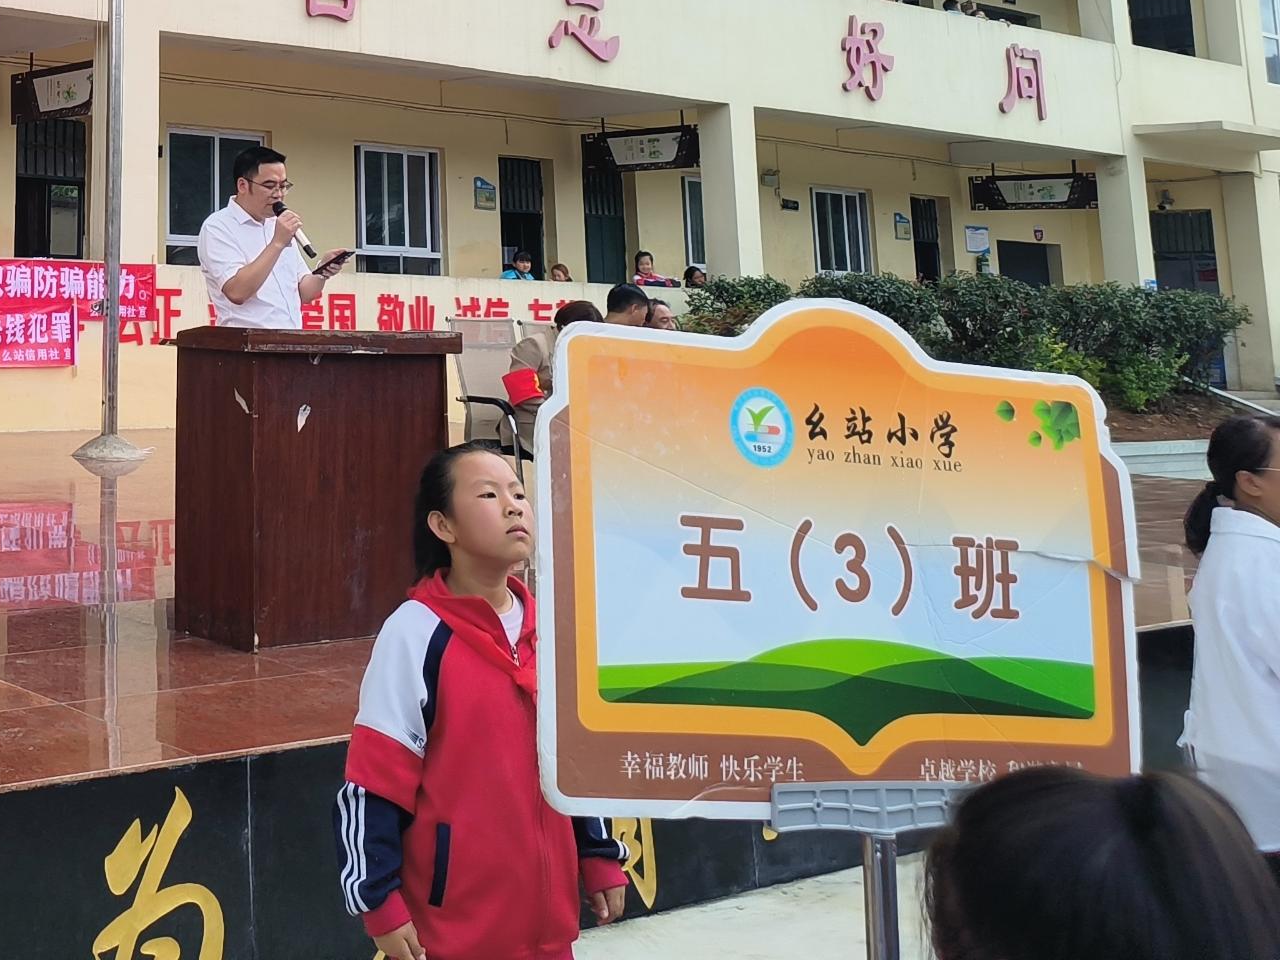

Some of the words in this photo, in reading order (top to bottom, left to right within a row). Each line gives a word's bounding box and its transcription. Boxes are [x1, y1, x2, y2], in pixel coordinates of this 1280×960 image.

[841, 15, 894, 101] 好
[999, 43, 1047, 121] 问
[753, 444, 772, 454] 1952
[807, 447, 835, 465] yao
[843, 445, 882, 466] zhan
[890, 450, 924, 470] xiao
[932, 456, 963, 473] xue
[619, 751, 710, 782] 幸福教师
[719, 753, 806, 783] 快乐学生
[920, 757, 998, 782] 卓越学校
